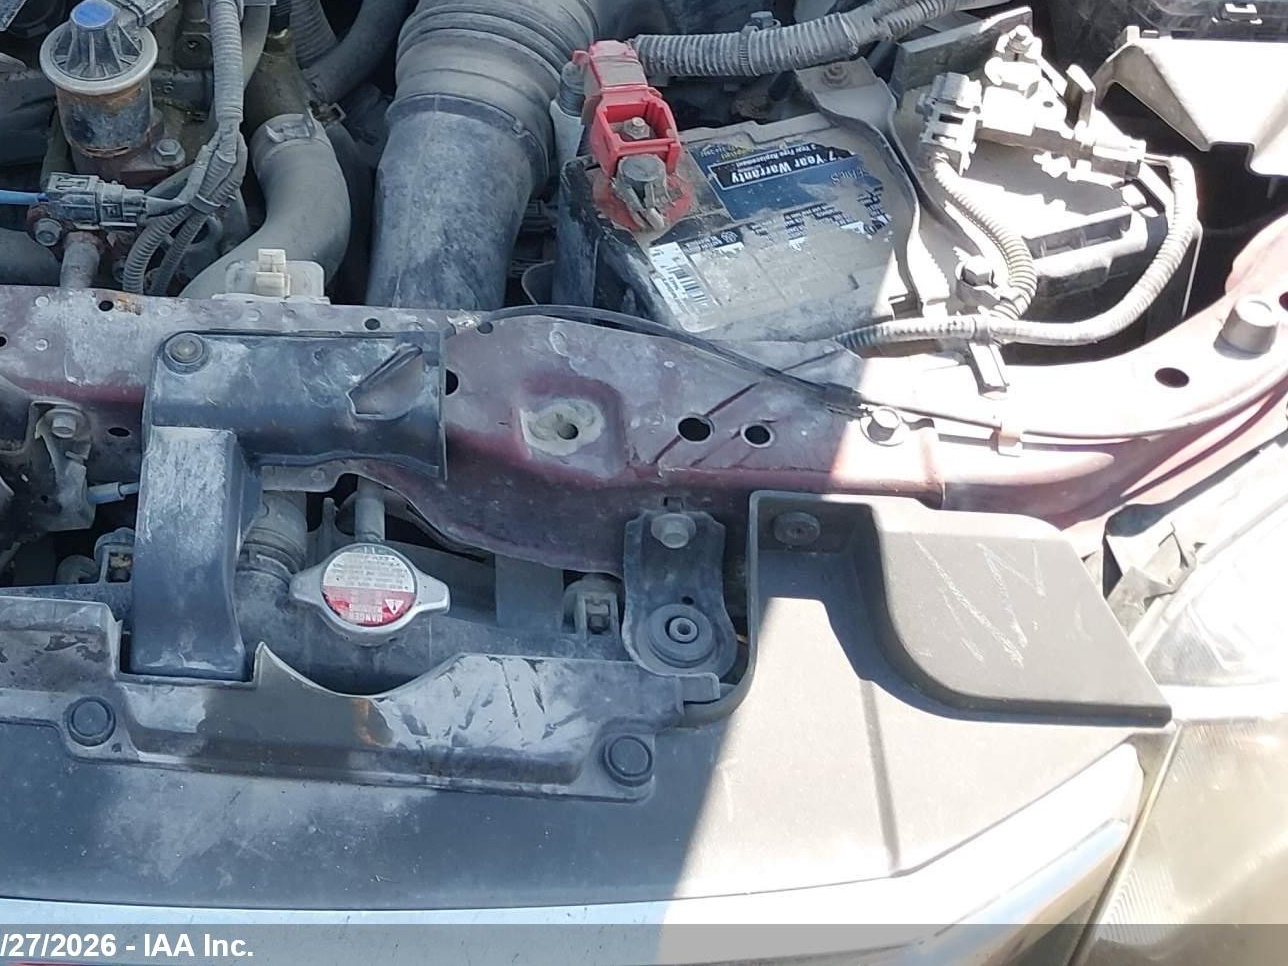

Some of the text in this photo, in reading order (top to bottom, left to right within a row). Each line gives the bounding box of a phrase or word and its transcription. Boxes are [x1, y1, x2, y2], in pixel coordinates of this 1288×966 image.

[779, 148, 796, 156] Free
[828, 150, 837, 162] 7
[736, 153, 779, 167] Replacement
[794, 153, 825, 168] Year
[731, 161, 793, 184] Warranty
